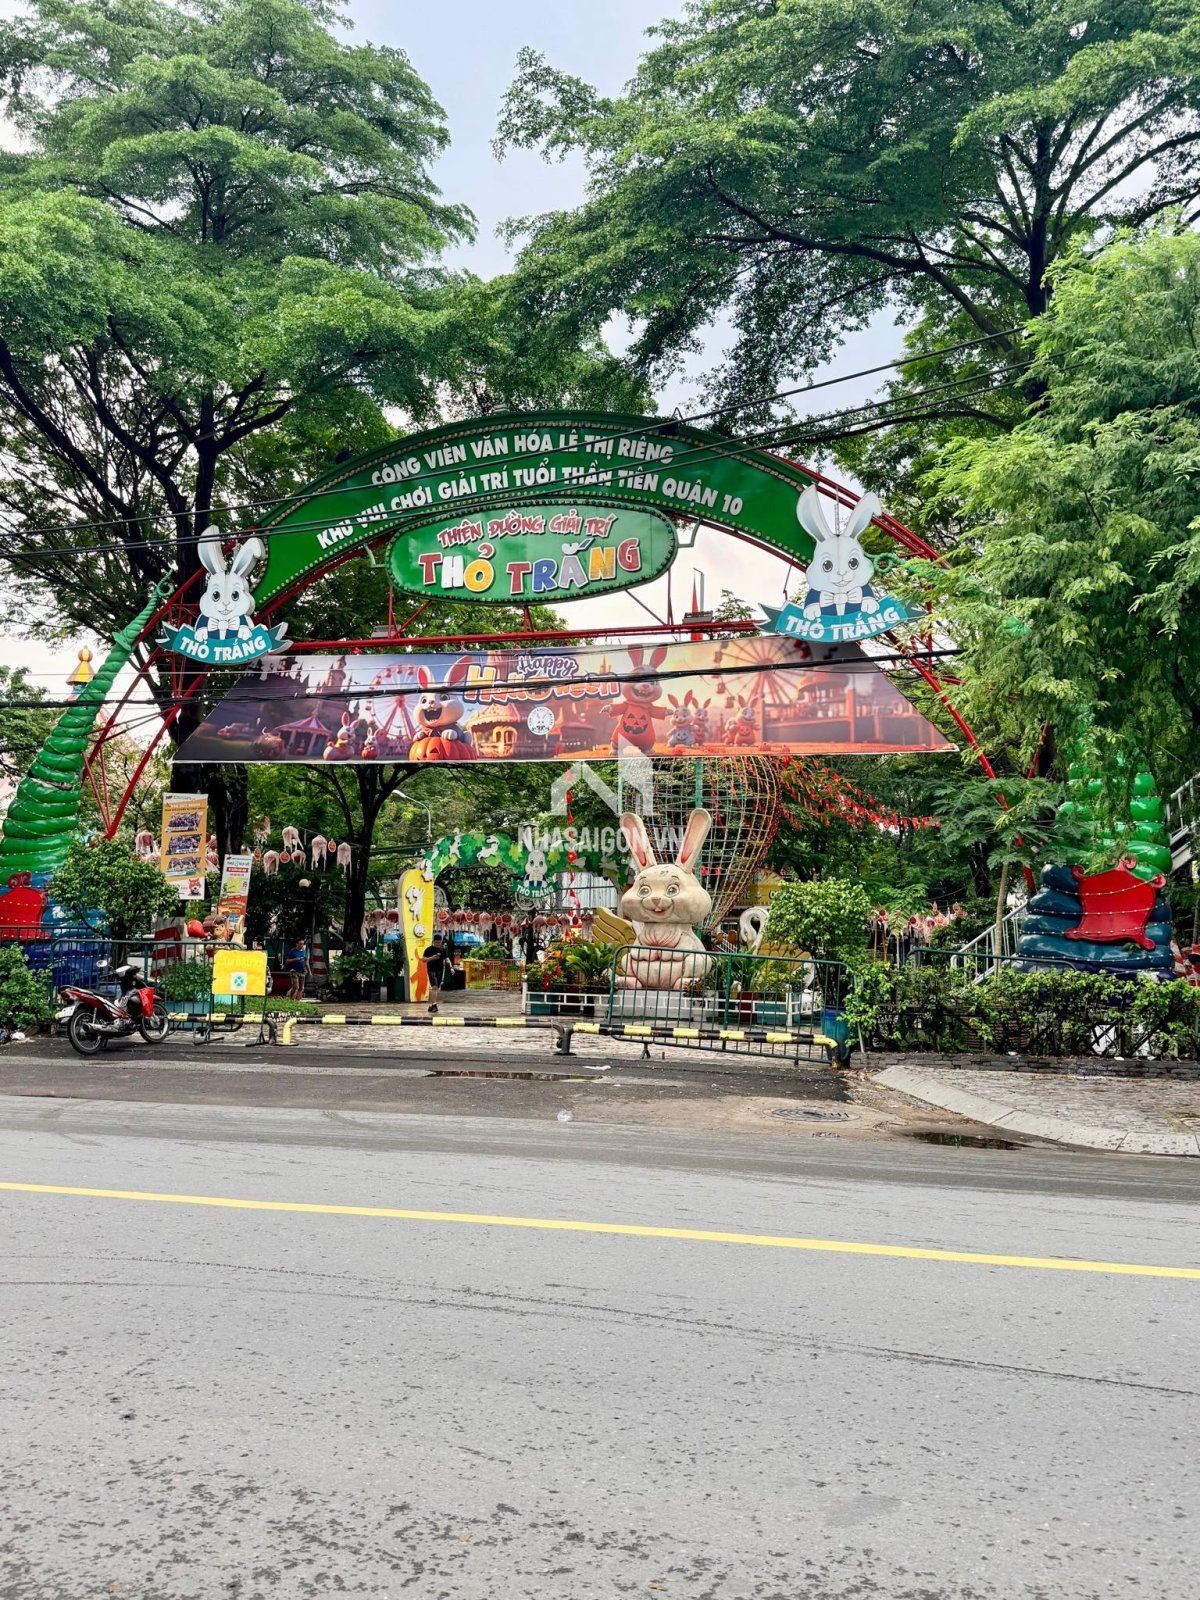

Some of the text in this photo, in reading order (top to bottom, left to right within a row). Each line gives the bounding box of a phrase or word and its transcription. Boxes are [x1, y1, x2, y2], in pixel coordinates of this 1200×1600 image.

[371, 429, 674, 488] CÔNG VIÊN VĂN HÓA LÊ THỊ RIÊNG
[316, 457, 744, 549] KHU VUI CHƠI GIẢI TRÍ TUỔI THẦN TIÊN QUẬN 10
[437, 508, 618, 549] THIÊN ĐƯỜNG GIẢI TRÍ
[418, 537, 641, 595] THỎ TRẮNG
[785, 606, 900, 640] THỎ TRẮNG
[180, 636, 267, 661] THỎ TRẮNG
[517, 655, 578, 677] Happy
